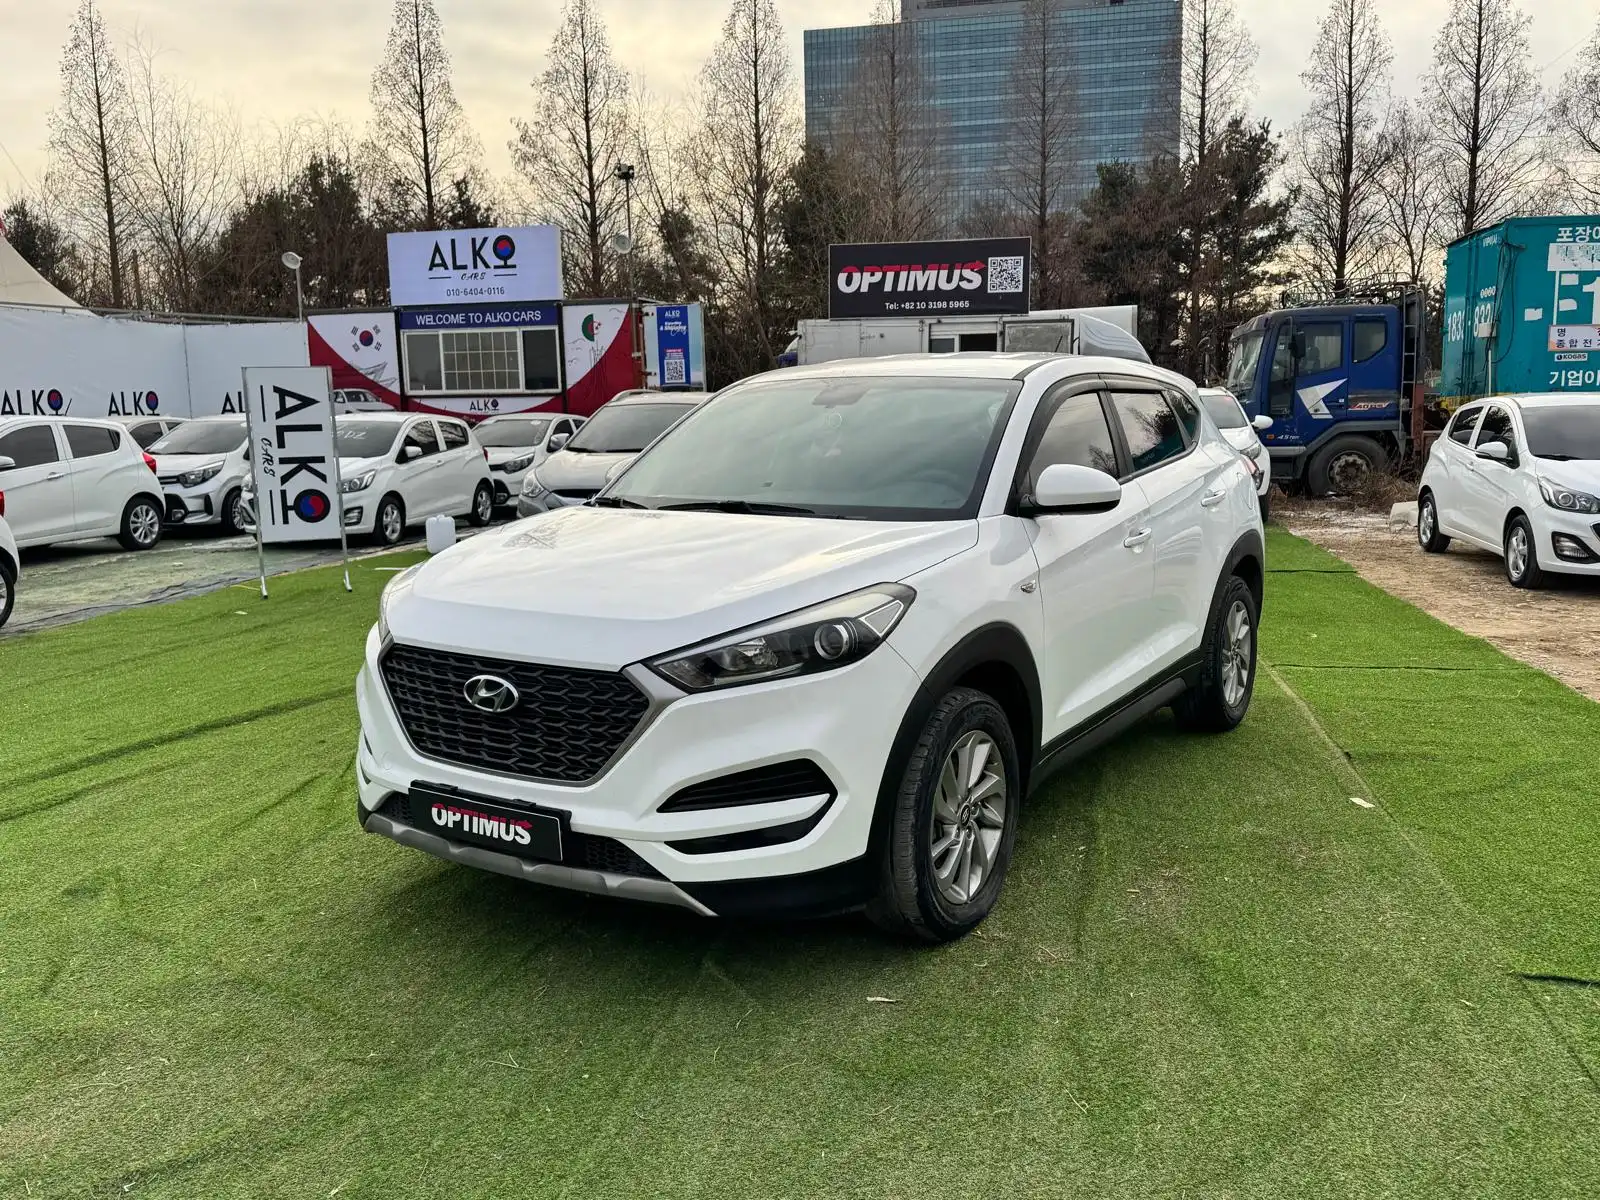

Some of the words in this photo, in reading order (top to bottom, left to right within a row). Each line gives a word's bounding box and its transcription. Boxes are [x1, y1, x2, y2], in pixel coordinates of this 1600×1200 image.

[428, 235, 517, 271] ALKO
[461, 272, 486, 281] CARS
[837, 260, 985, 294] OPTIMUS
[446, 287, 505, 297] 010-6404-0116
[884, 302, 899, 310] Tel:
[916, 301, 926, 309] 10
[928, 301, 947, 309] 3198
[949, 300, 970, 308] 5965
[415, 313, 466, 326] WELCOME
[468, 312, 483, 323] TO
[485, 312, 511, 323] ALKO
[513, 310, 541, 321] CARS
[1, 389, 65, 416] ALKO
[108, 391, 160, 416] ALKO
[221, 391, 246, 414] AL
[469, 399, 499, 411] ALKO
[261, 437, 276, 478] CARS
[273, 385, 331, 525] ALKO
[431, 803, 533, 845] OPTIMUS
